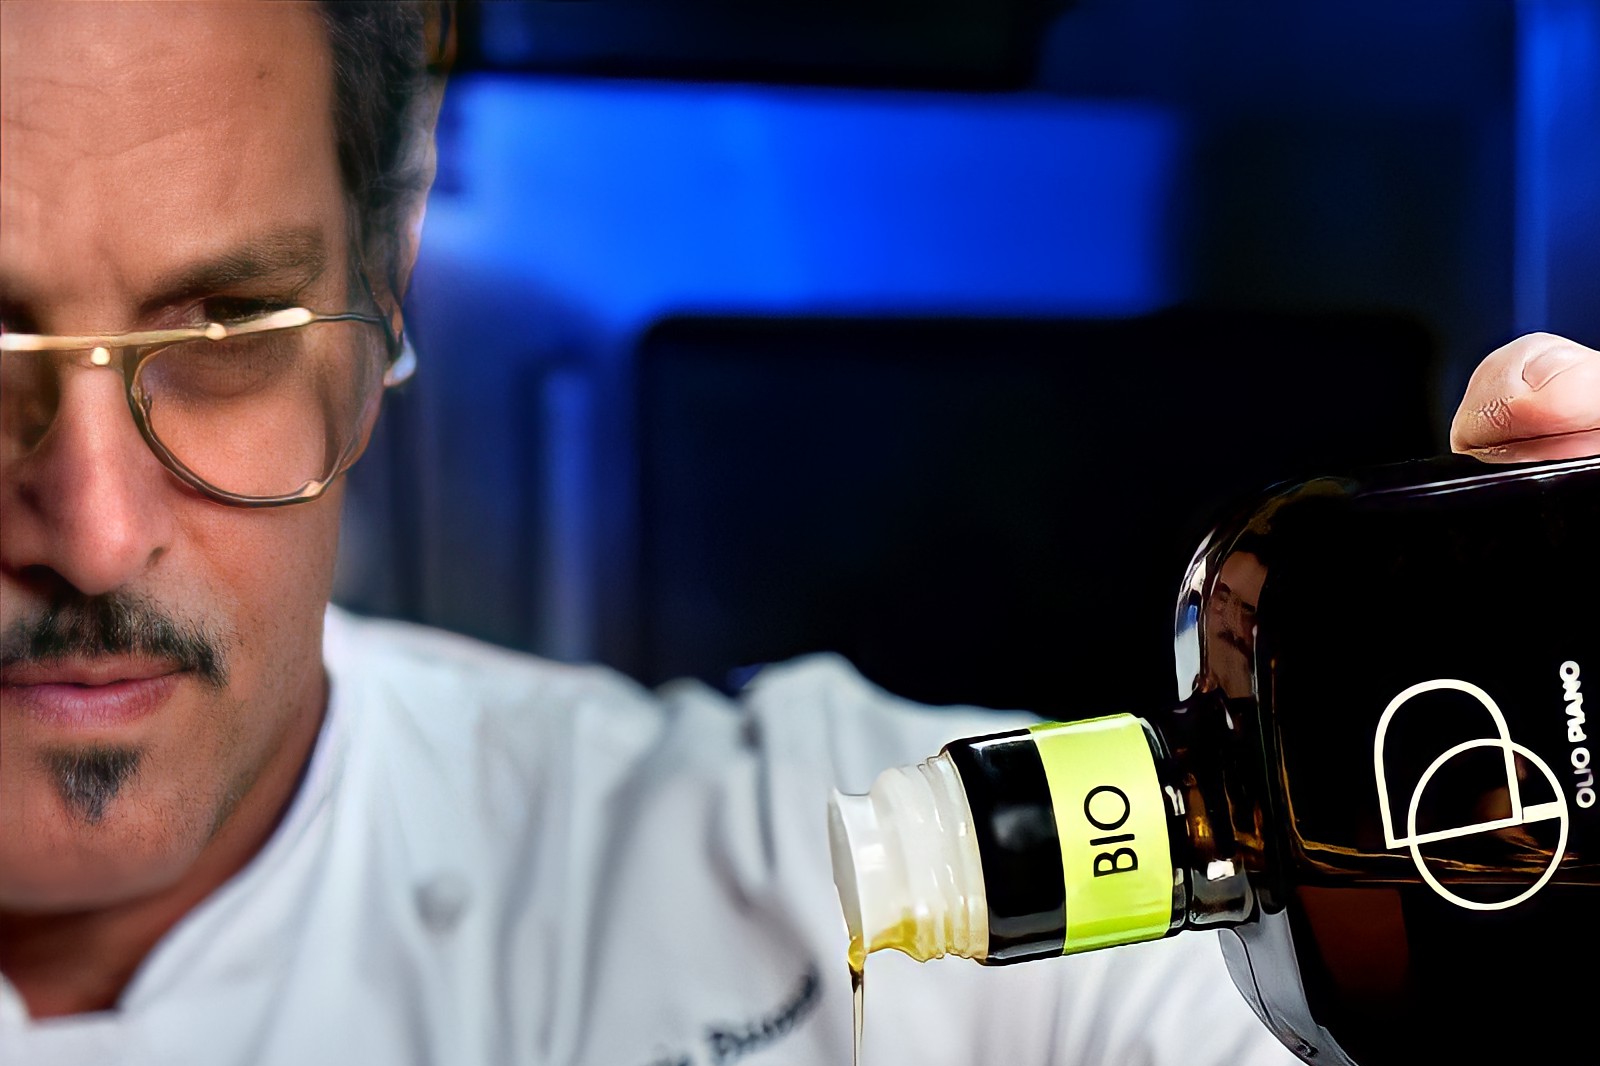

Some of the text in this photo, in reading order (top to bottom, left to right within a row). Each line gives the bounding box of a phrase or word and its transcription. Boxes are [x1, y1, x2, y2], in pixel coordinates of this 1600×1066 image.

[1559, 660, 1598, 809] OLIO PIANO
[1083, 785, 1139, 878] BIO
